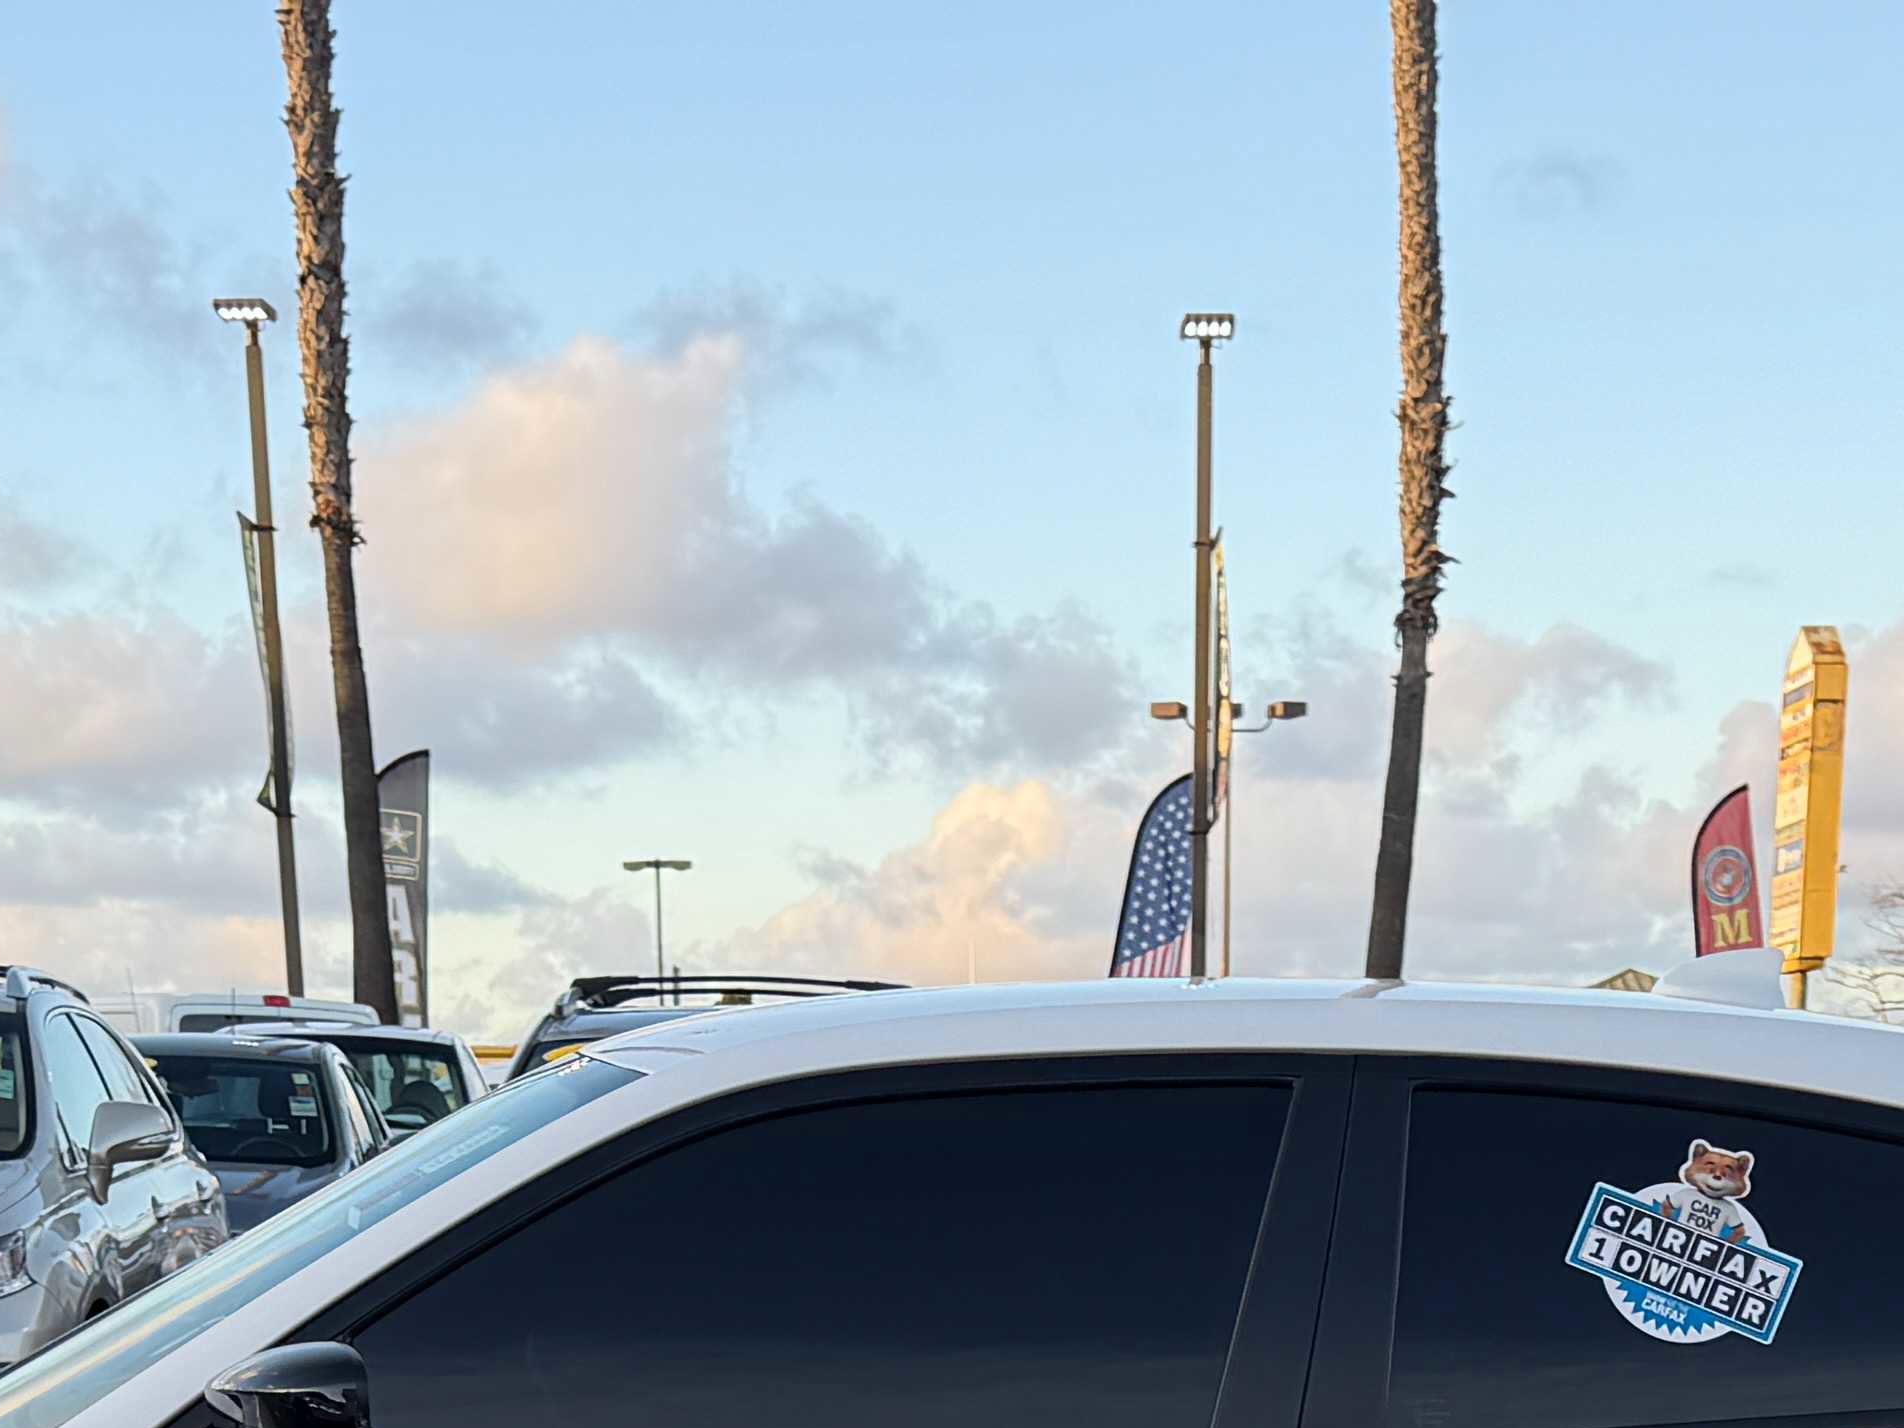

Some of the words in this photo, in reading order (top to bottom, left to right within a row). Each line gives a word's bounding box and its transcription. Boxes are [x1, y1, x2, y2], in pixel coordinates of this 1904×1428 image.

[1712, 905, 1753, 948] M
[1686, 1211, 1716, 1233] FOX
[1691, 1199, 1722, 1220] CAR
[1601, 1204, 1781, 1298] CARFAX
[1587, 1236, 1607, 1263] 1
[1618, 1248, 1767, 1326] OWNER
[1640, 1297, 1688, 1325] CARFAX
